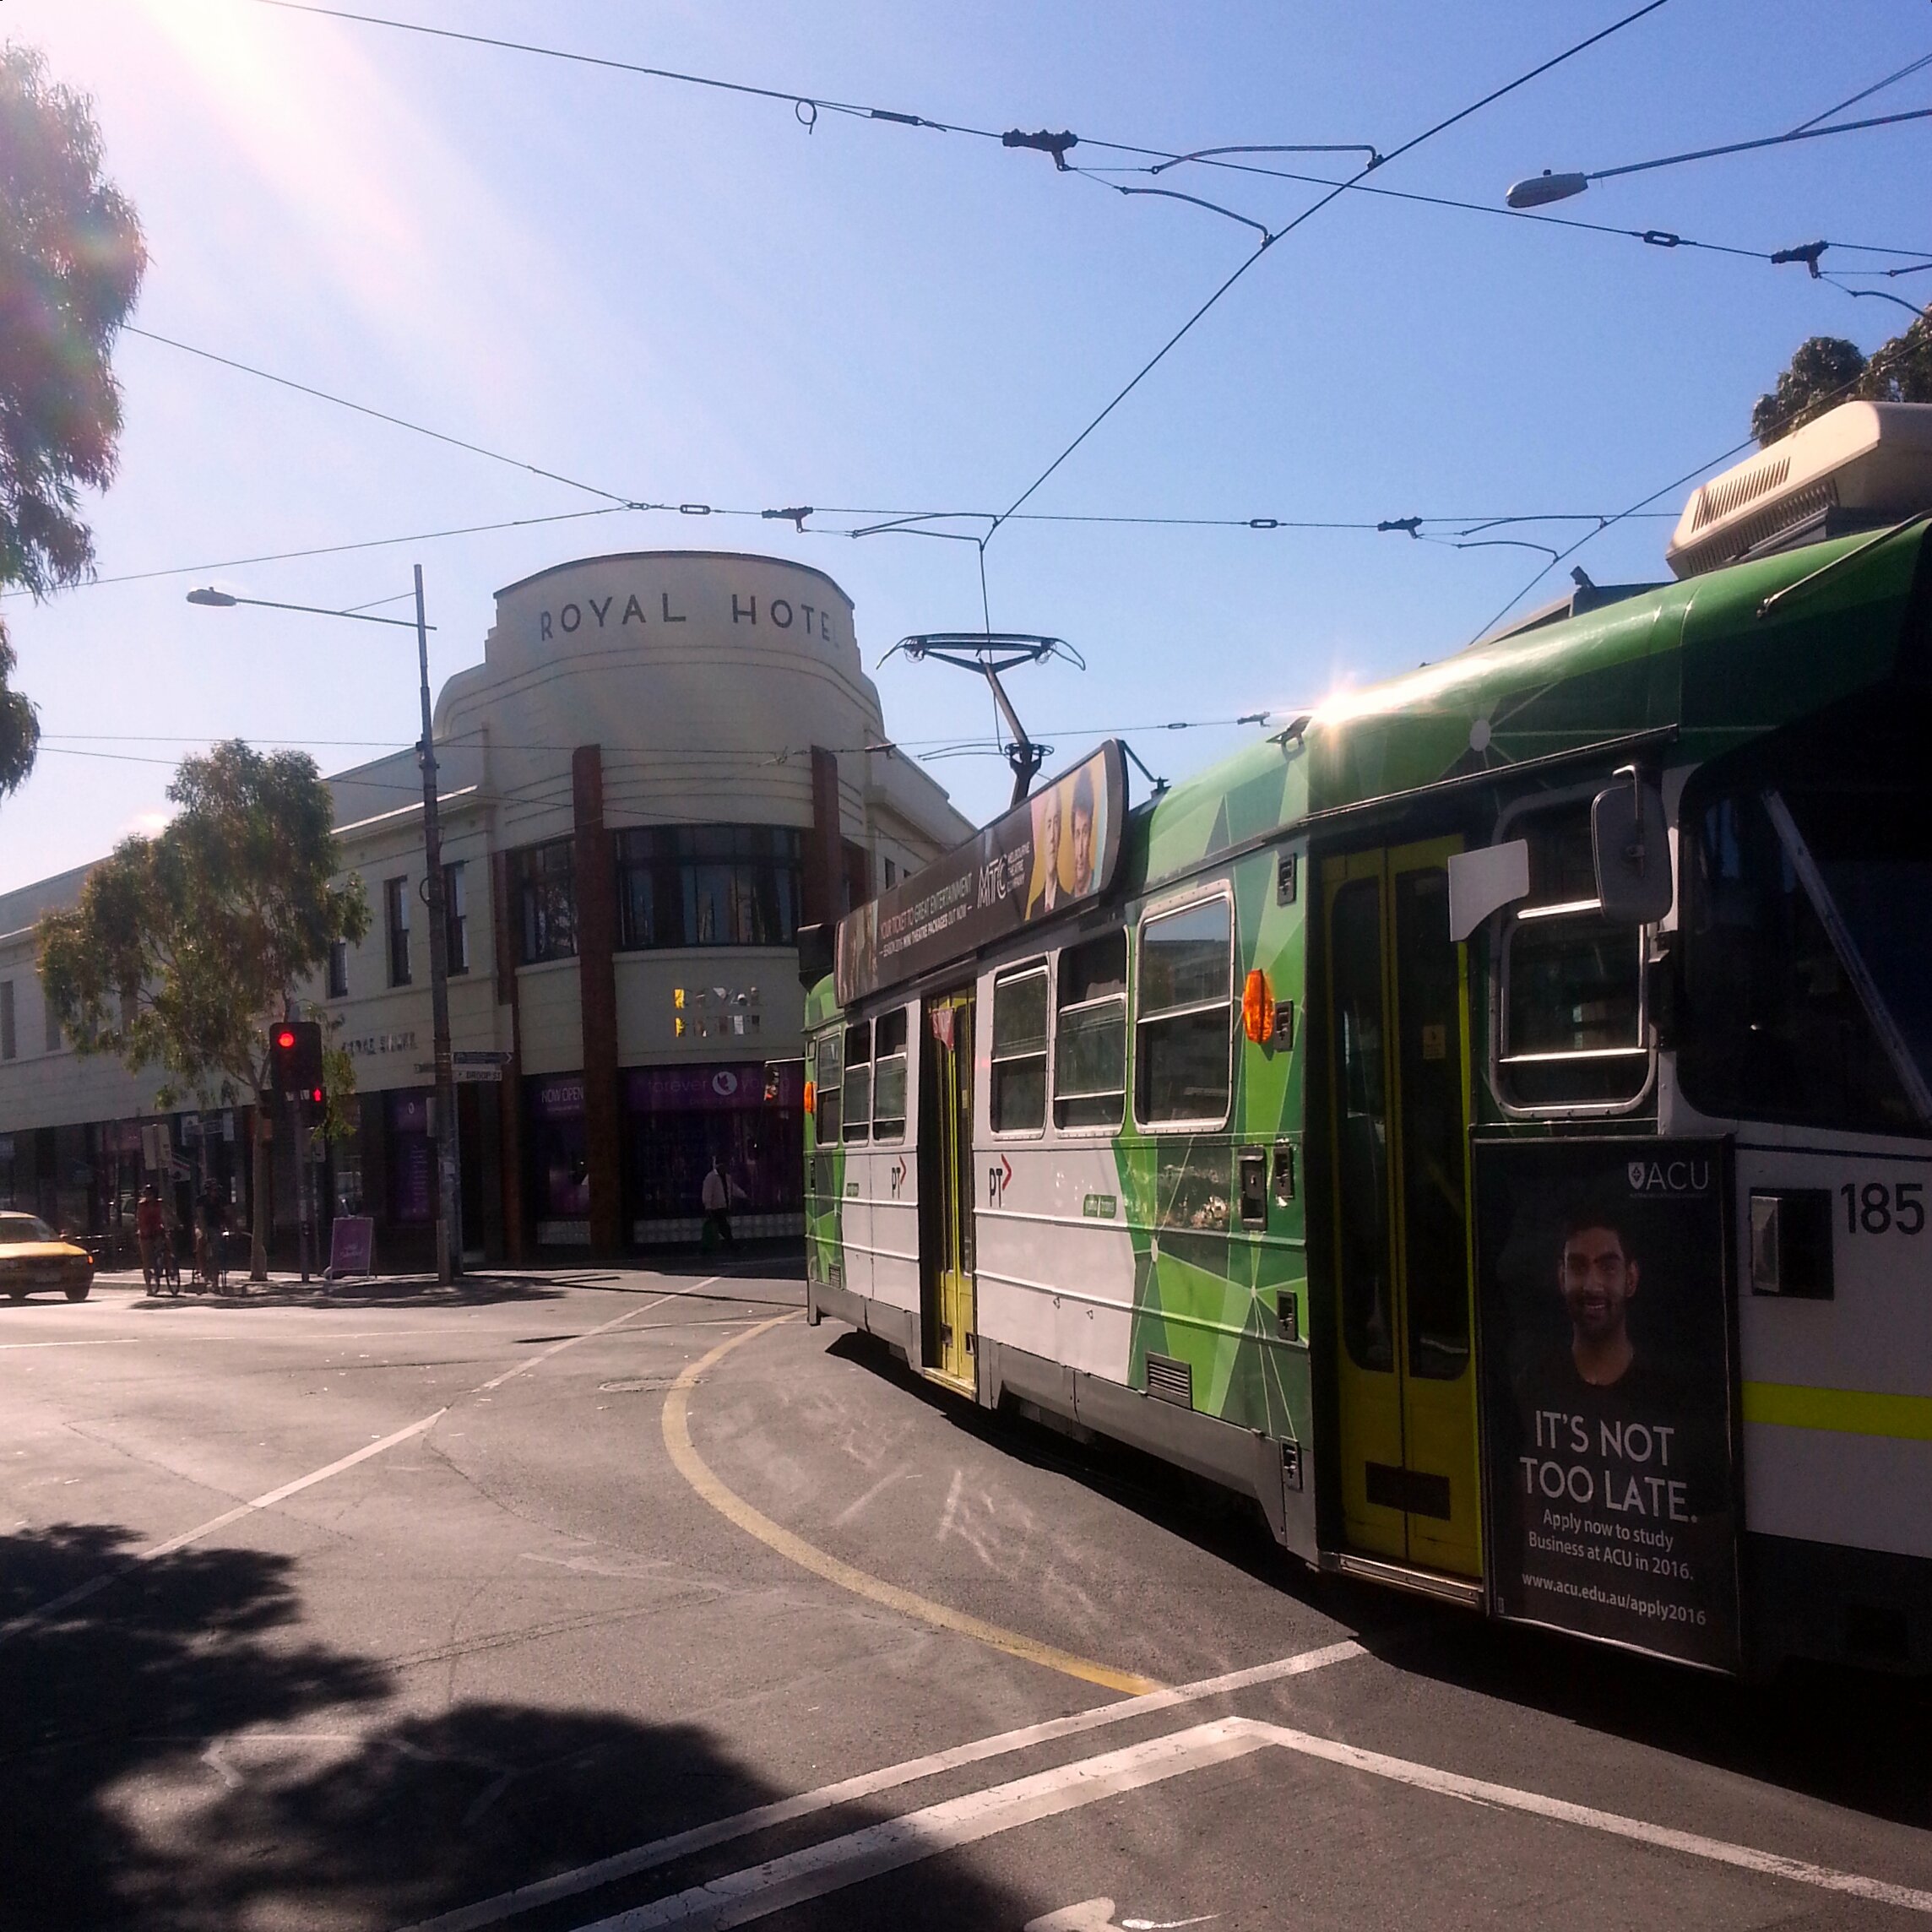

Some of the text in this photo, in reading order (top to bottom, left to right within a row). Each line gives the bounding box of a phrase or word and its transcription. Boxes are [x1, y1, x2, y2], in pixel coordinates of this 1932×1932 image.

[540, 592, 687, 642] ROYAL
[931, 871, 972, 914] ENTERTAINMENT
[977, 854, 1007, 909] MTC
[541, 1086, 584, 1104] NOW OPEN
[1646, 1161, 1709, 1190] ACU
[1841, 1182, 1925, 1235] 185
[1535, 1410, 1675, 1467] IT'S NOT
[1519, 1456, 1698, 1523] TOO LATE.
[1528, 1530, 1695, 1582] Business at ACU in 2016.
[1543, 1508, 1674, 1553] Apply now to study
[1521, 1571, 1707, 1626] www.acu.edu.au/apply2016
